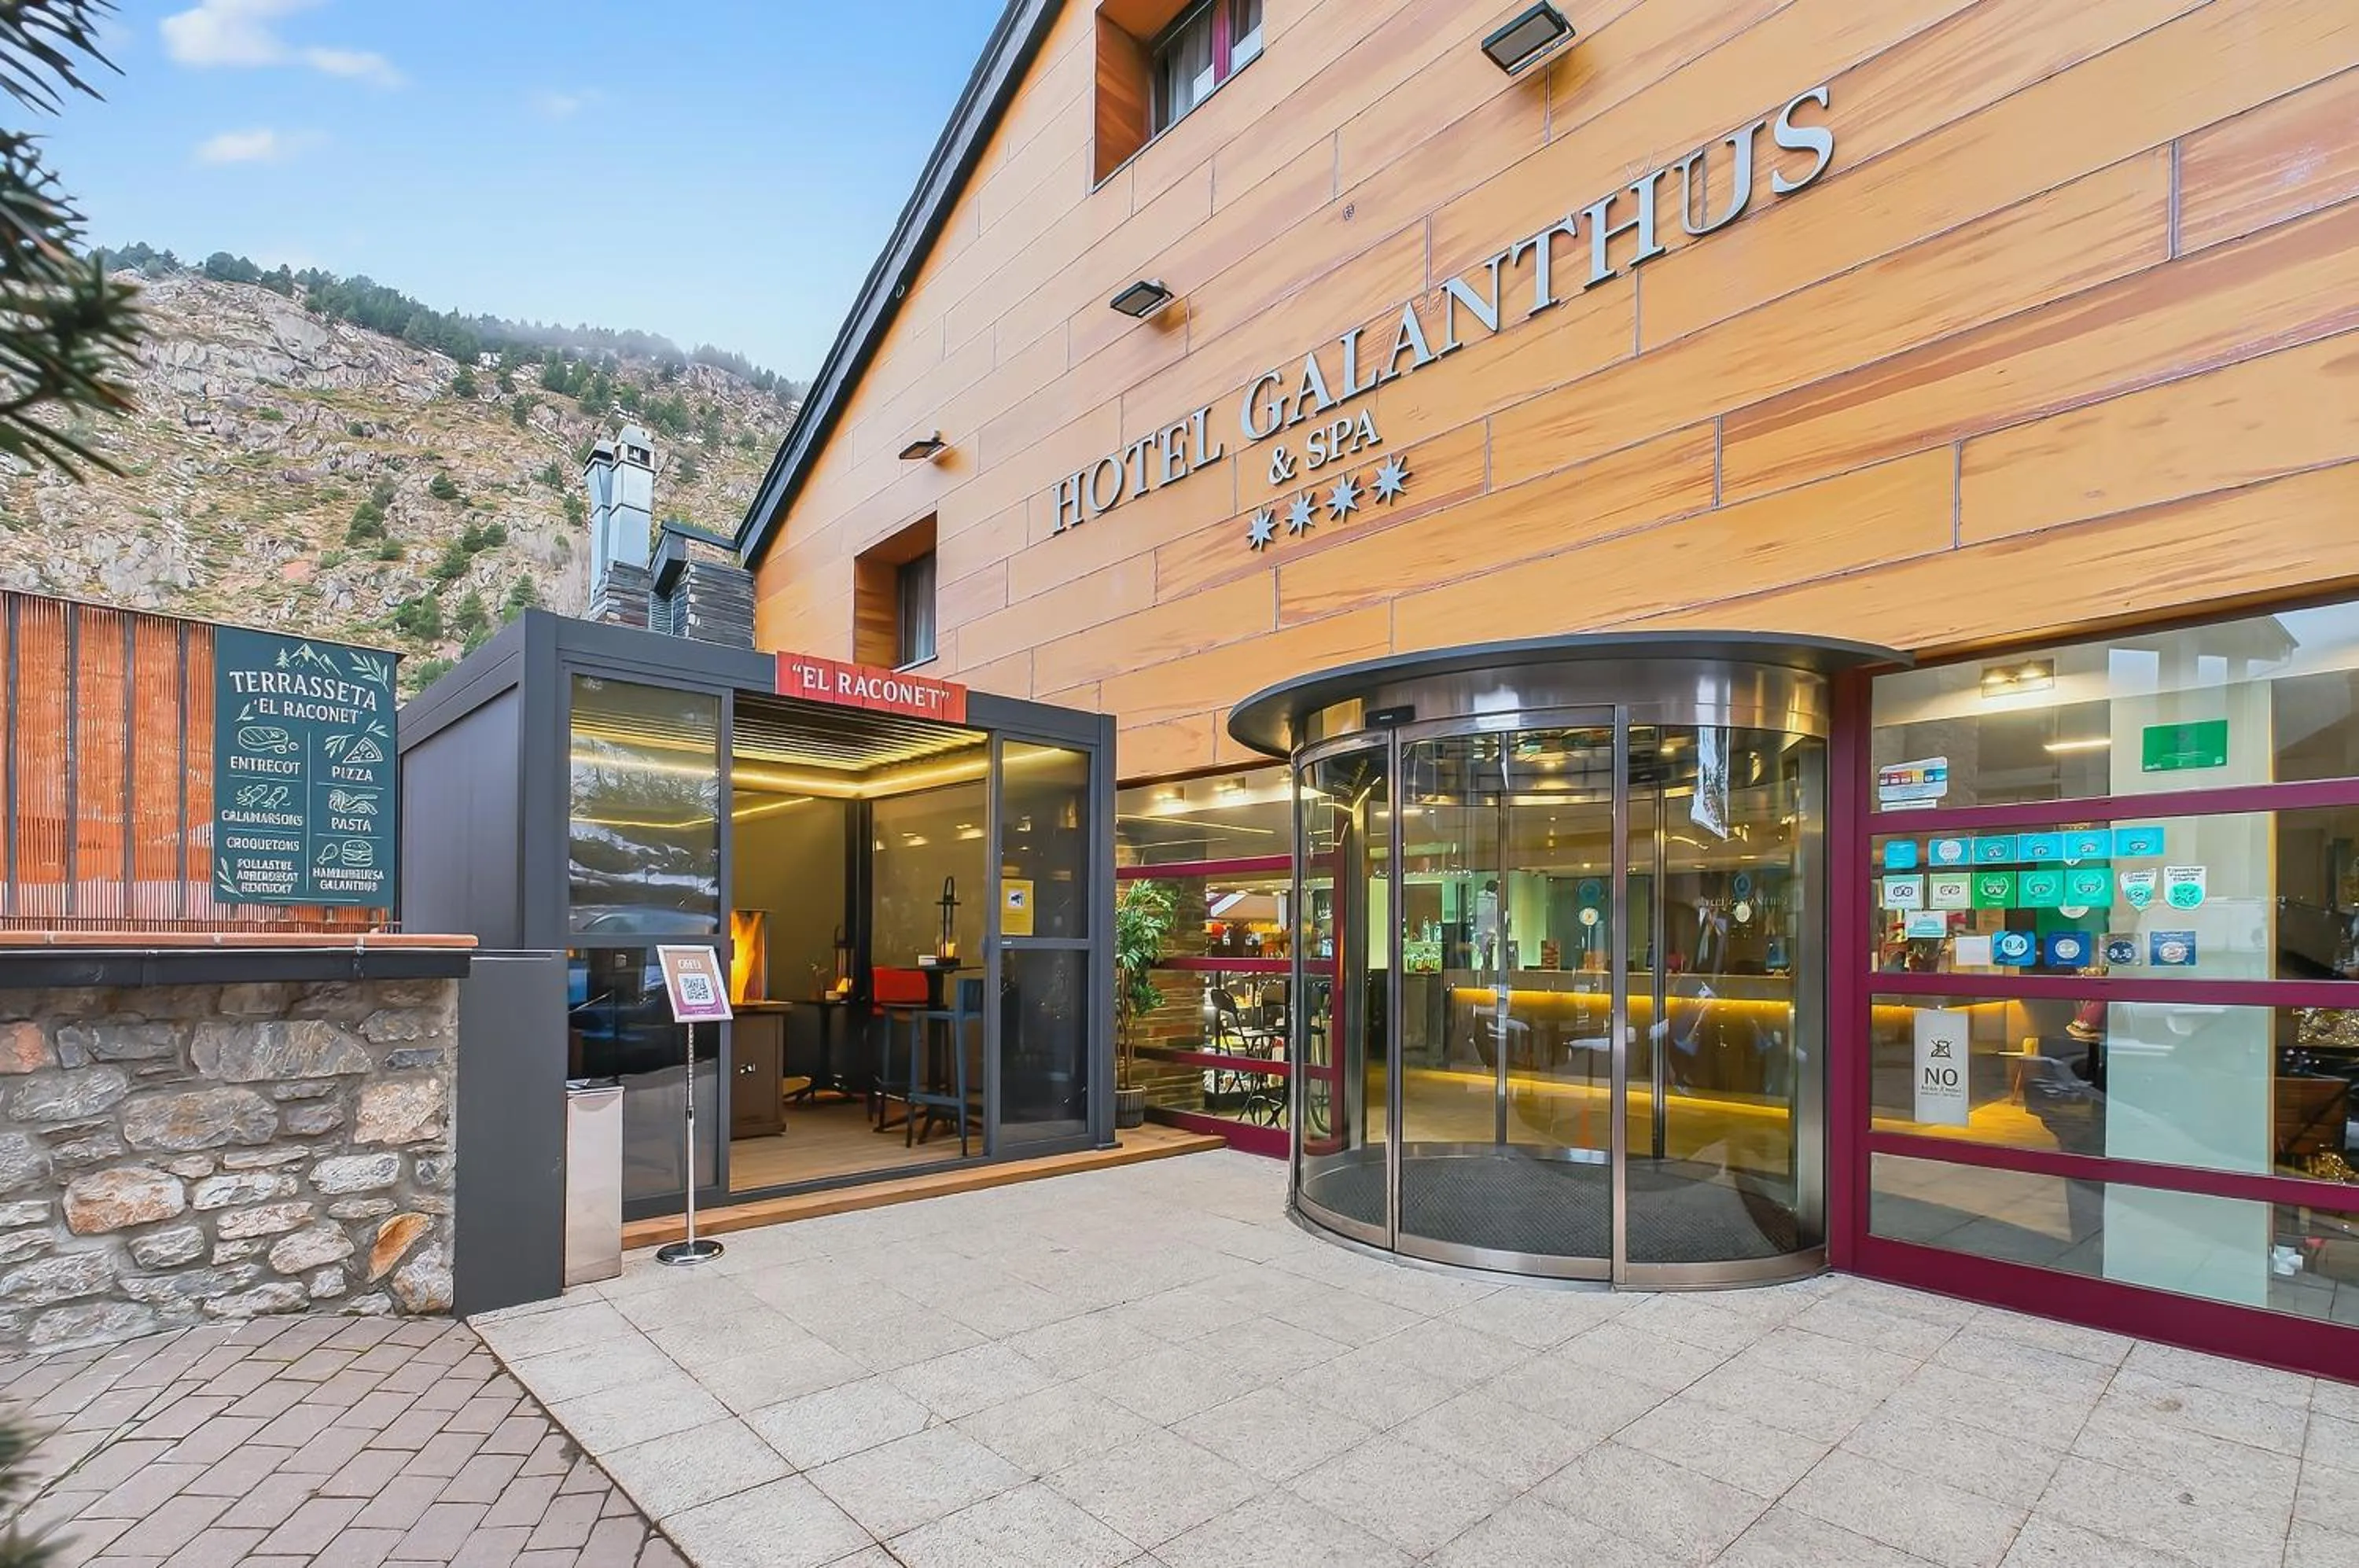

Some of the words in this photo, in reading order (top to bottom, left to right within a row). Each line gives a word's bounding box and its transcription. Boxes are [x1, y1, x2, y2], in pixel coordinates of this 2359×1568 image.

[1051, 406, 1224, 536] HOTEL
[1240, 86, 1835, 442] GALANTHUS
[1268, 445, 1297, 486] &
[1307, 408, 1383, 471] SPA
[229, 671, 377, 712] TERRASSETA
[230, 756, 301, 775] ENTRECOT
[332, 765, 374, 782] PIZZA
[331, 817, 372, 832] PASTA
[1924, 1067, 1959, 1087] NO
